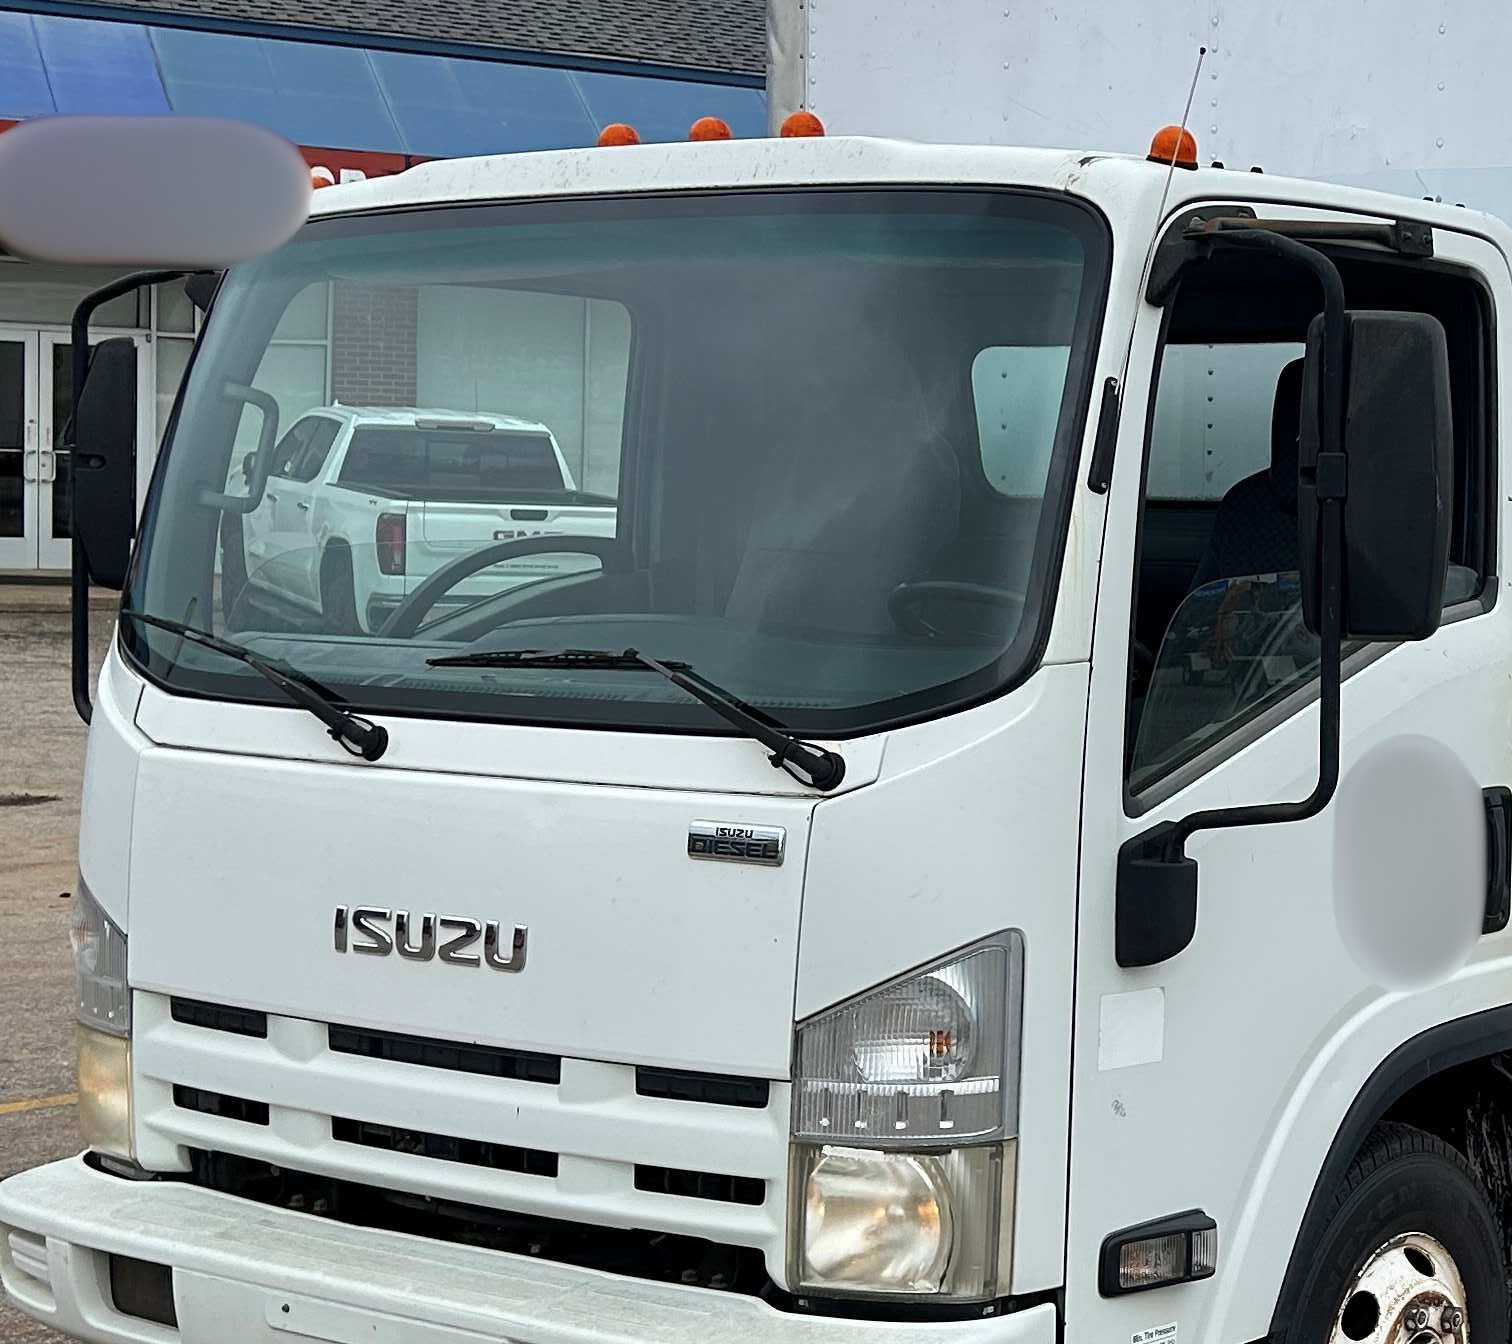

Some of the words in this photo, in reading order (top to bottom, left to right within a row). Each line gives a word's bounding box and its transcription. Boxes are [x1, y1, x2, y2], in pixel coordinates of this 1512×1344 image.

[715, 827, 754, 838] ISUZU
[689, 836, 779, 859] DIESEL
[334, 904, 529, 973] ISUZU
